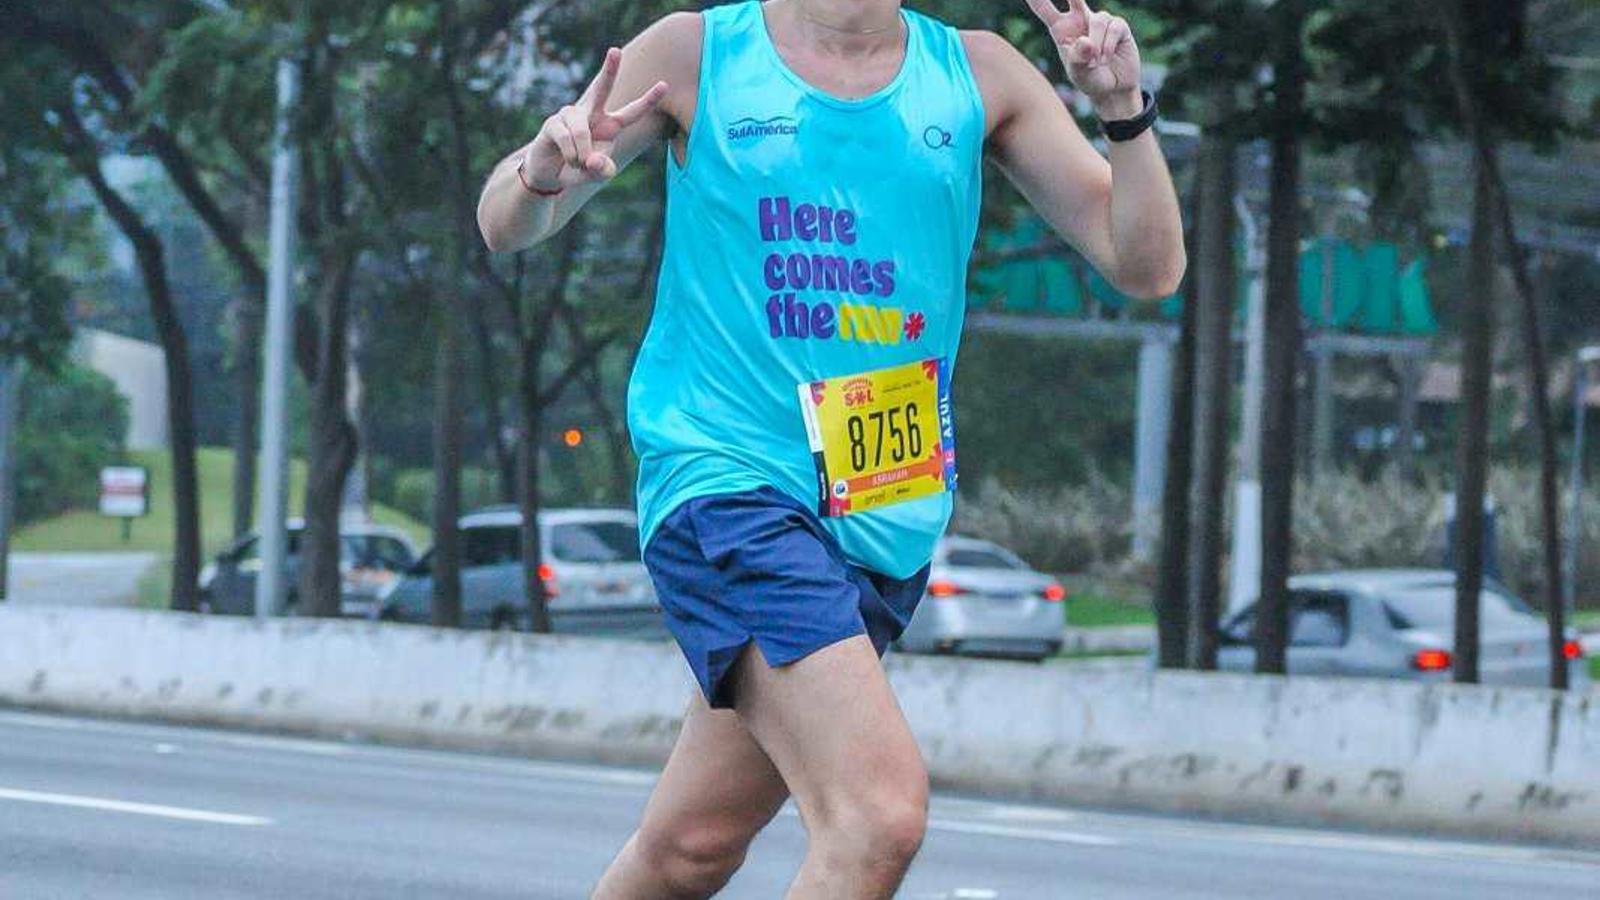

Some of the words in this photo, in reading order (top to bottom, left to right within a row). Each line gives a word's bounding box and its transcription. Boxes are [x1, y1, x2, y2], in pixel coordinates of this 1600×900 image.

[758, 197, 857, 245] Here
[763, 253, 896, 297] comes
[765, 293, 835, 339] the
[847, 402, 922, 472] 8756
[938, 396, 953, 438] AZUL
